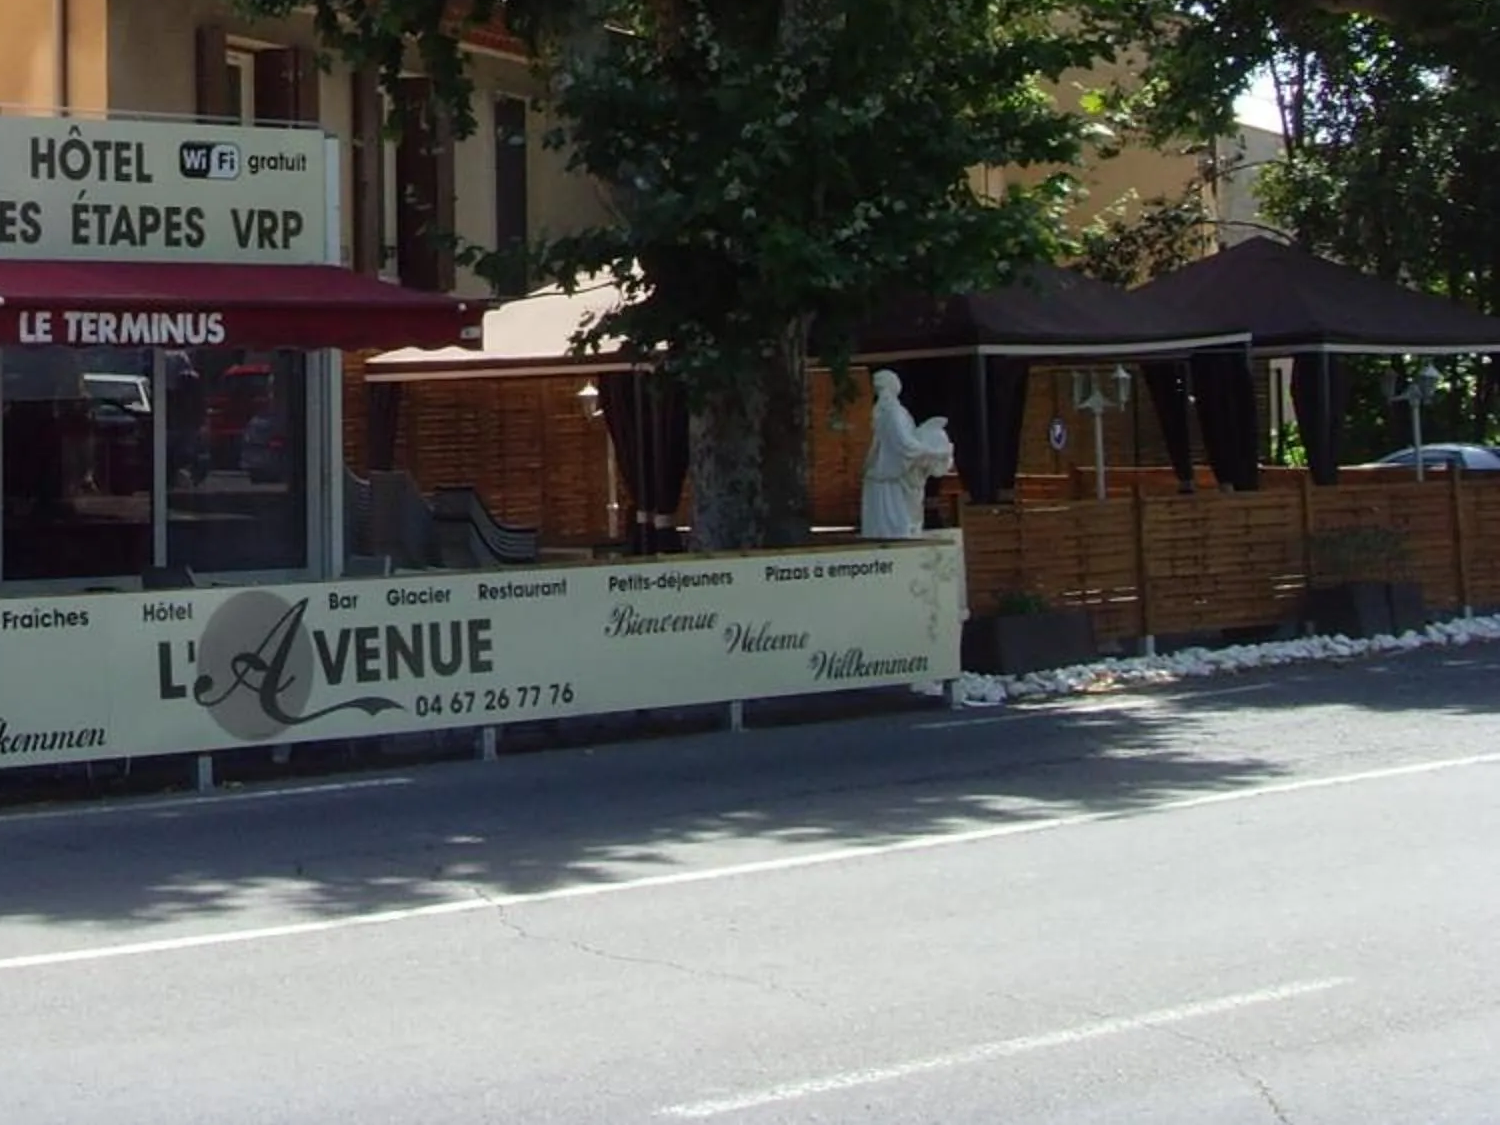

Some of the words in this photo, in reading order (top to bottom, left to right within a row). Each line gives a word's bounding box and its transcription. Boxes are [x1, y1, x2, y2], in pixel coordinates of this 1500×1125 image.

[31, 125, 153, 183] HÔTEL
[247, 152, 307, 175] gratuit
[72, 191, 206, 249] ÉTAPES
[231, 208, 304, 250] VRP
[19, 311, 53, 342] LE
[64, 312, 225, 344] TERMINUS
[764, 565, 810, 582] Pizzas
[827, 560, 894, 579] emporter
[143, 602, 193, 621] Hôtel
[329, 593, 358, 610] Bar
[386, 587, 451, 607] Glacier
[478, 579, 567, 602] Restaurant
[604, 605, 718, 639] Bienvenue
[723, 621, 810, 655] Welcome
[807, 650, 930, 681] Willkommen
[157, 597, 495, 725] L'AVENUE
[415, 692, 443, 717] 04
[449, 690, 476, 714] 67
[483, 688, 511, 711] 26
[518, 685, 542, 708] 77
[549, 682, 575, 706] 76
